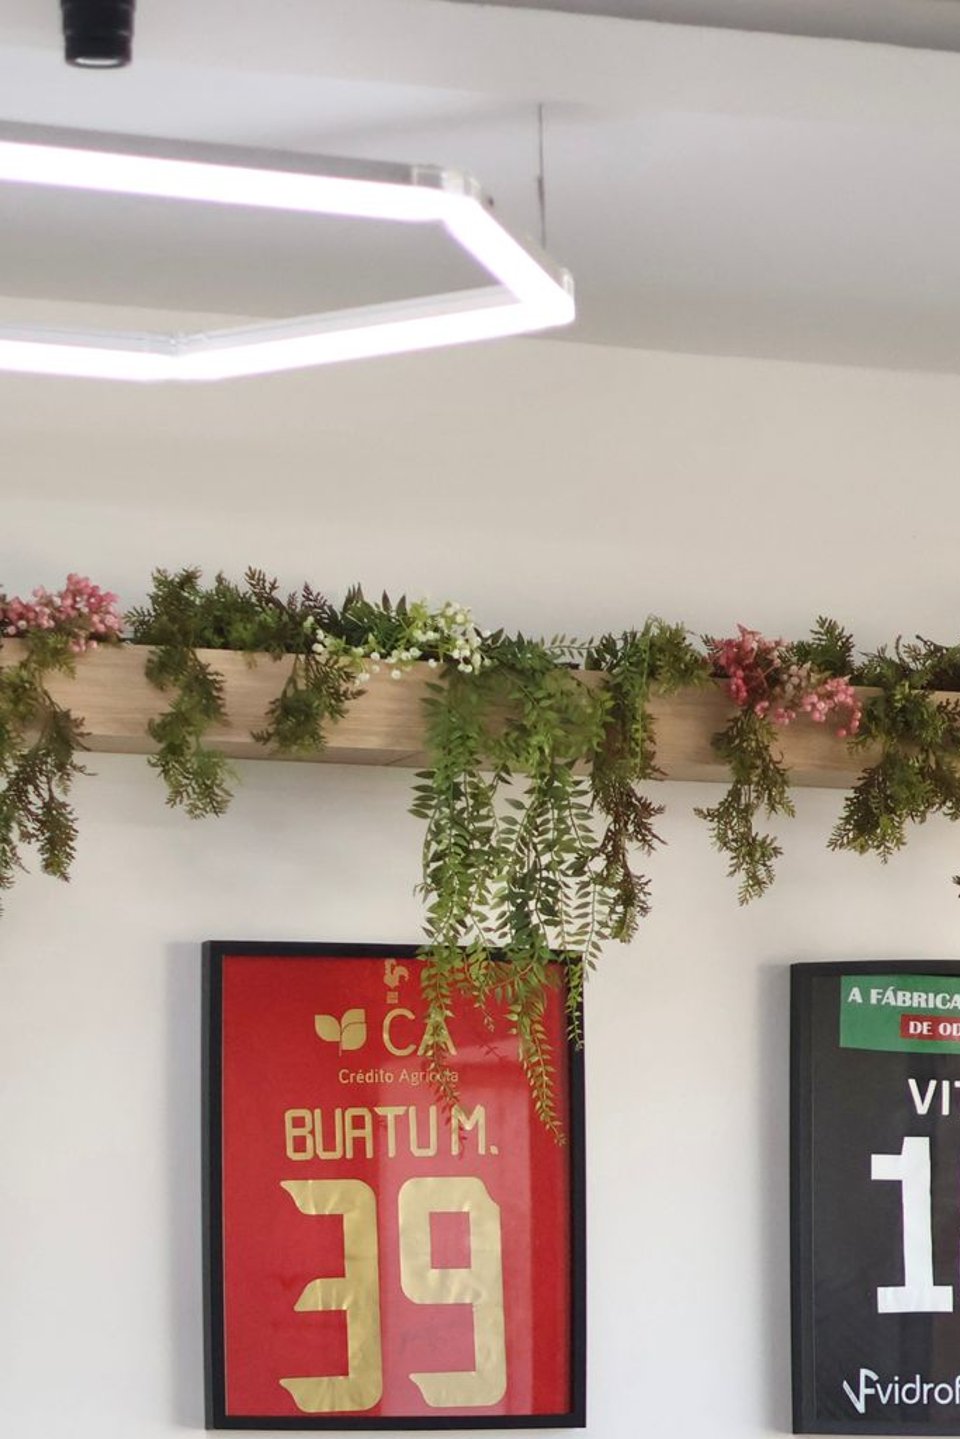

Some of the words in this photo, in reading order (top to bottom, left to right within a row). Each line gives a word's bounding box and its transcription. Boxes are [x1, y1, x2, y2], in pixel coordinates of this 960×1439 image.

[847, 986, 863, 1004] A
[382, 1007, 457, 1056] CA
[908, 1020, 933, 1036] DE
[338, 1068, 394, 1084] Crédito
[284, 1105, 439, 1162] BUATU
[279, 1175, 508, 1414] 39
